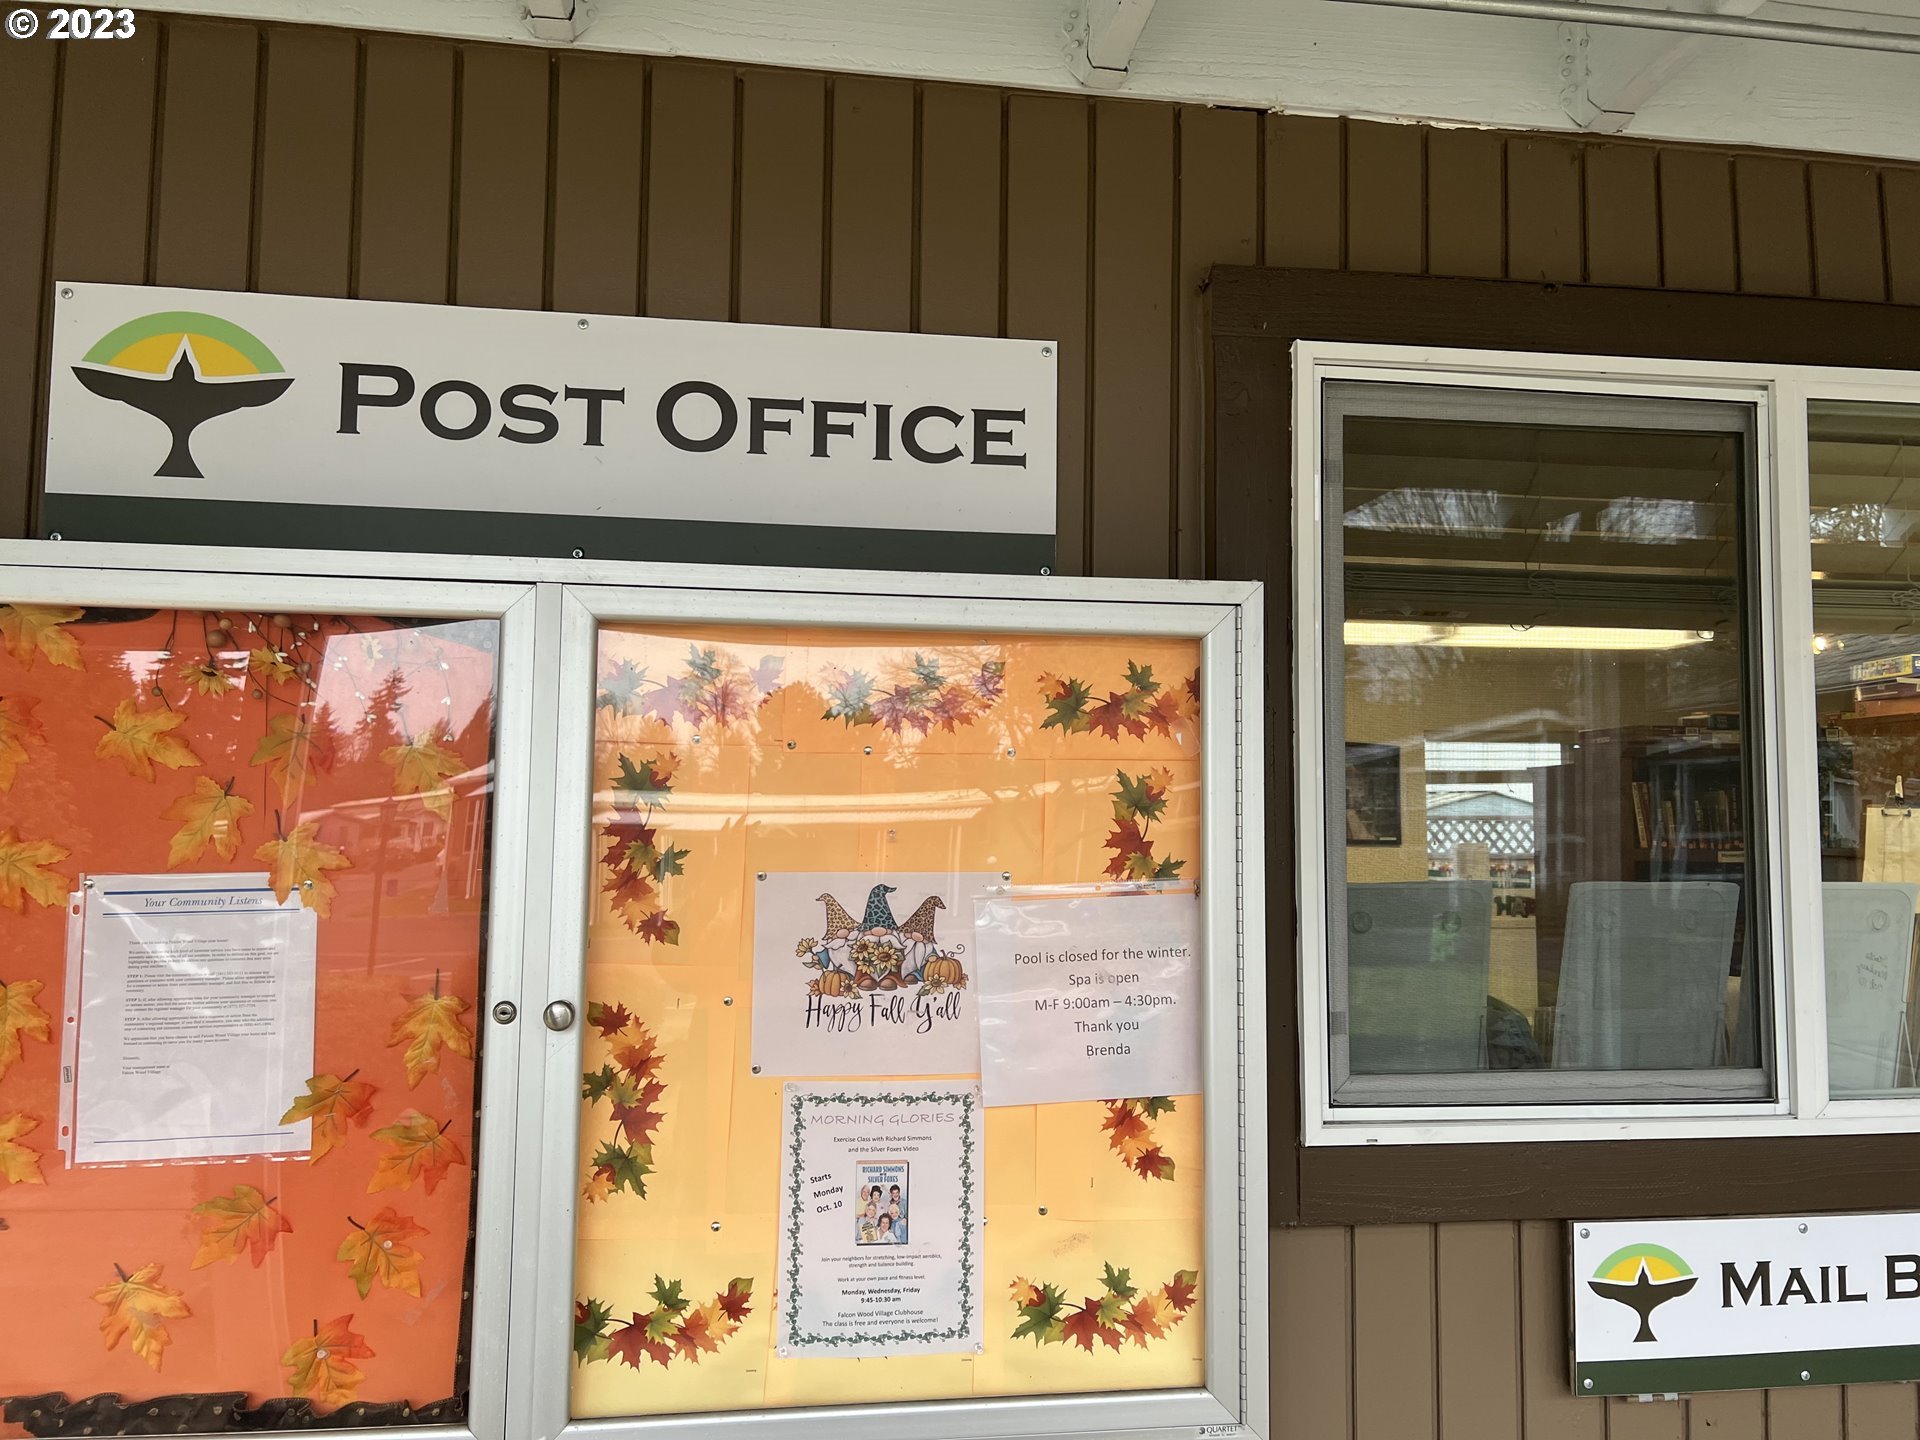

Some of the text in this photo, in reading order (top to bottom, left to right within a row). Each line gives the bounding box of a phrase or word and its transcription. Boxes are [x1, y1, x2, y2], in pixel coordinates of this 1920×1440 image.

[335, 362, 1027, 469] POST OFFICE
[144, 896, 263, 908] Your Community Listens
[1014, 947, 1191, 965] Pool is closed for the winter.
[1068, 973, 1139, 987] Spa is open
[1035, 998, 1059, 1011] M-F
[1062, 997, 1110, 1010] 9:00am
[1124, 994, 1176, 1009] 4:30pm.
[805, 993, 863, 1033] Happy
[869, 993, 906, 1025] Fall
[1074, 1020, 1139, 1034] Thank you
[1086, 1043, 1131, 1057] Brenda
[811, 1113, 954, 1126] MORNING GLORIES
[810, 1173, 831, 1183] Starts
[813, 1186, 843, 1198] Monday
[817, 1205, 832, 1213] Oct.
[1720, 1260, 1868, 1308] MAIL
